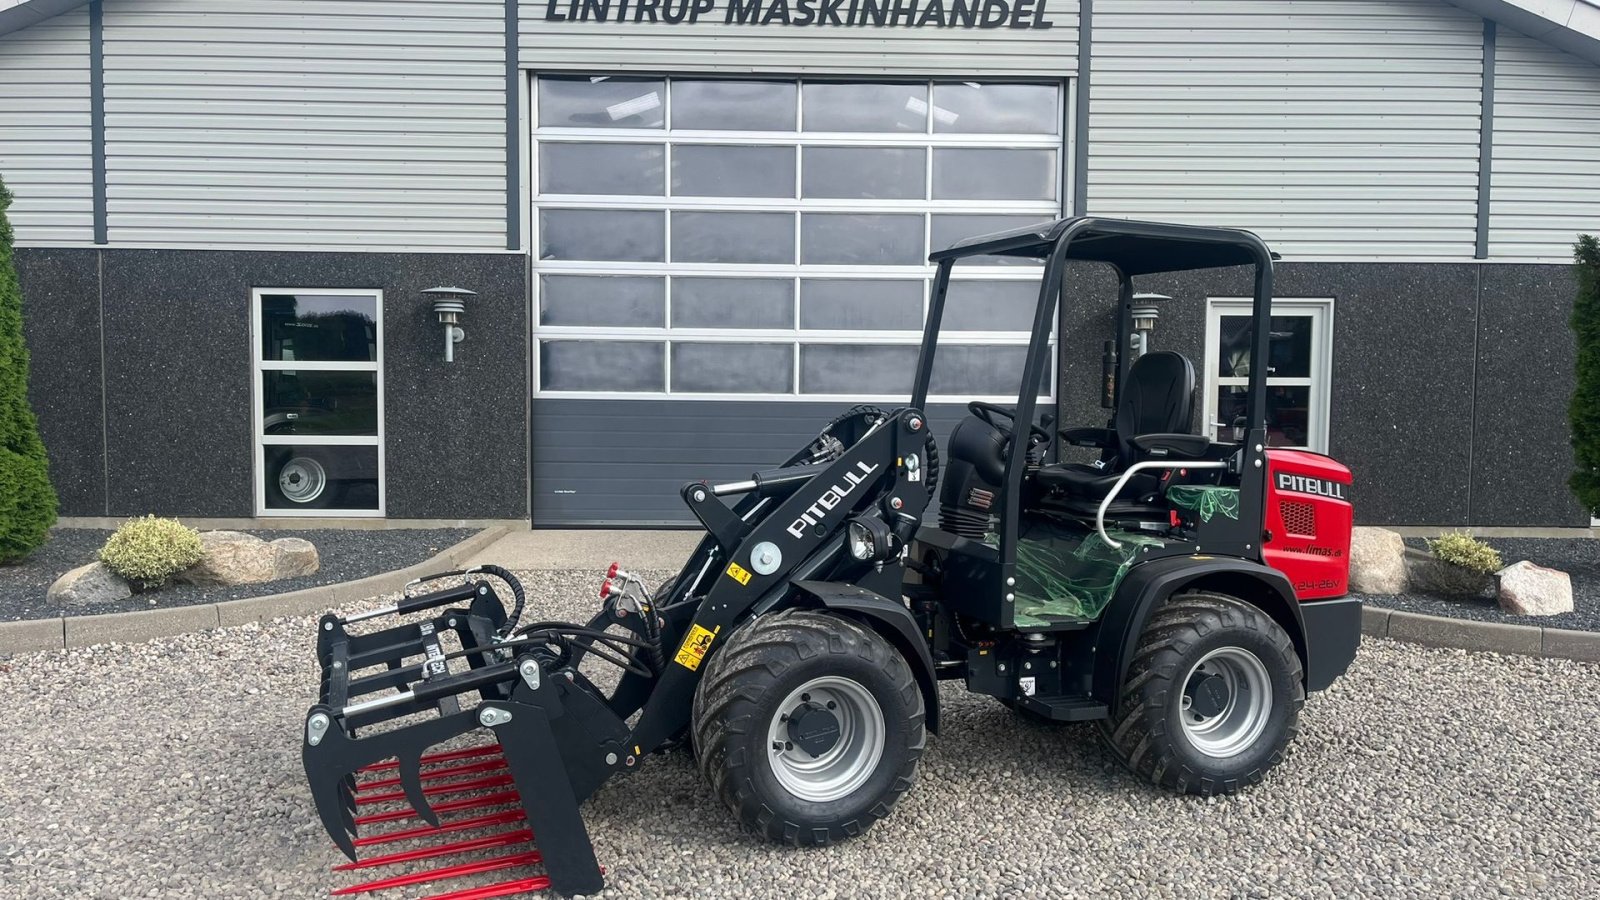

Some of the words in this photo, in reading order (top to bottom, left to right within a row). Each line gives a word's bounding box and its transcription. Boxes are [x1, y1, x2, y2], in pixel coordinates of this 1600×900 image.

[545, 0, 714, 24] LINTRUP
[724, 0, 1053, 29] MASKINHANDEL
[1279, 473, 1344, 499] PITBULL
[786, 461, 879, 539] PITBULL
[1282, 544, 1342, 557] www.limas.dk
